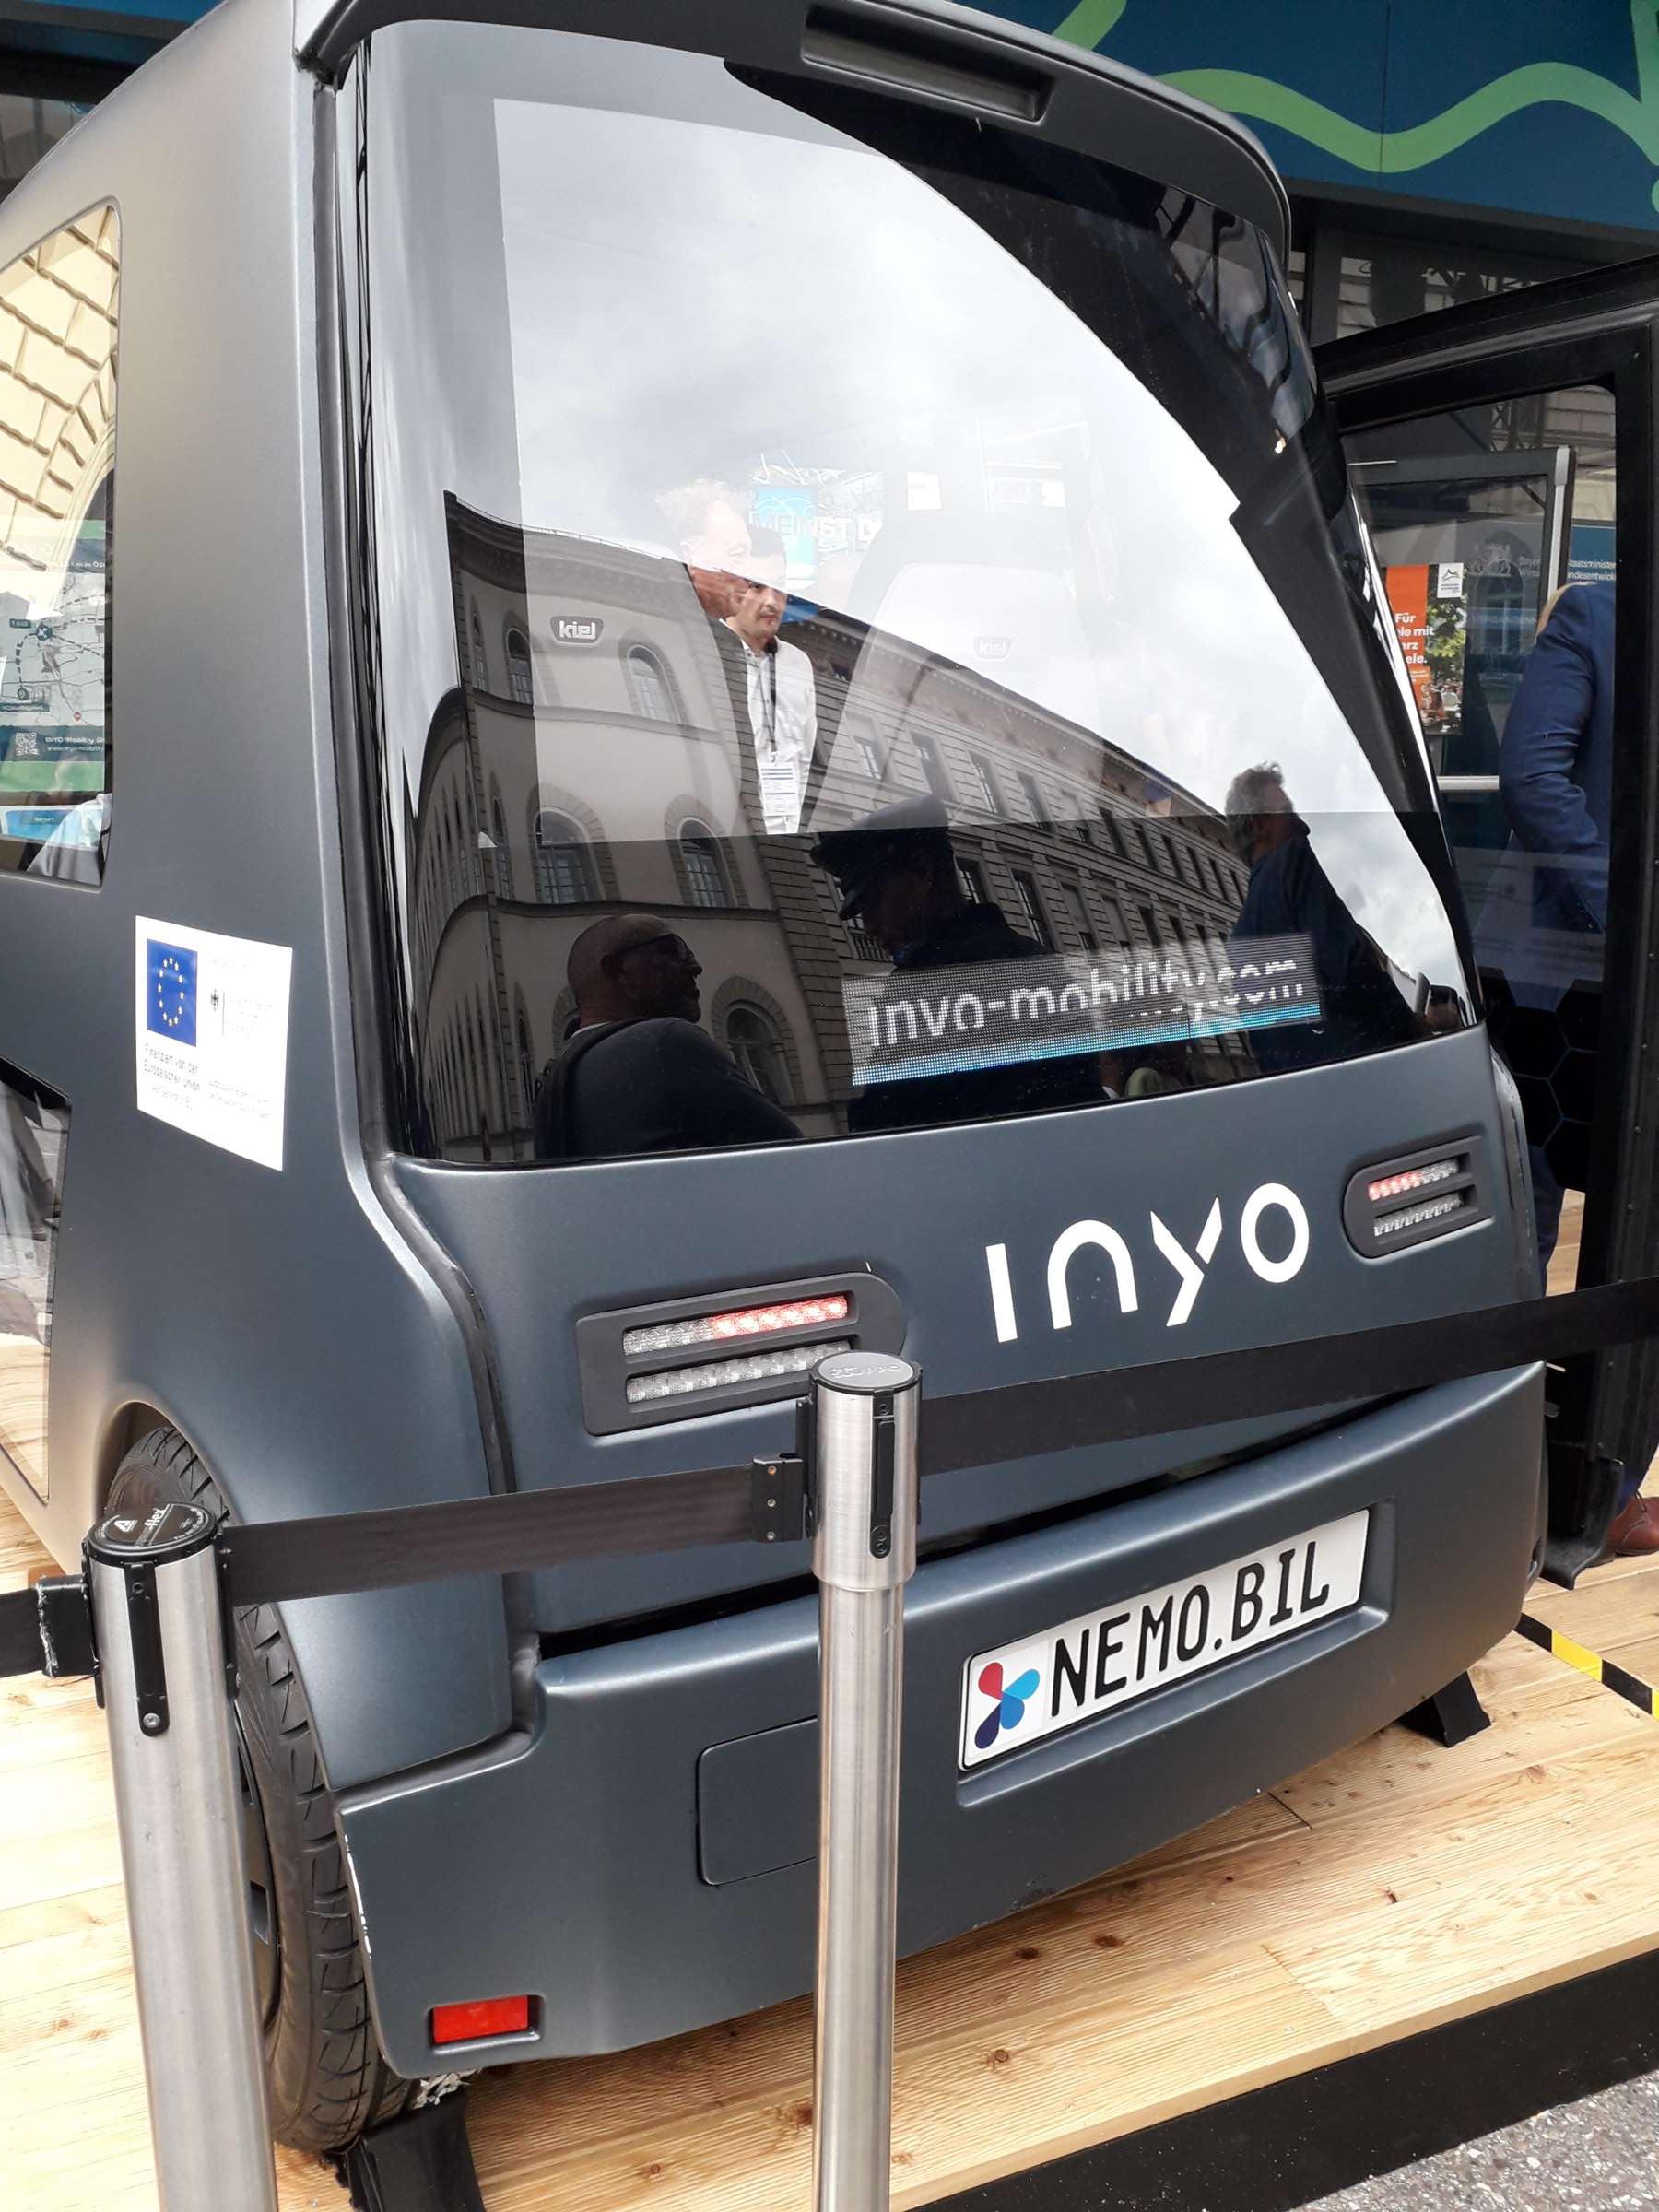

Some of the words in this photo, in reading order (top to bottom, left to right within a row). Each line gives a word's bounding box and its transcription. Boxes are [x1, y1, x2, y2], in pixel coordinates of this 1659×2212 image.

[1394, 611, 1417, 624] Für
[559, 620, 596, 640] kiel
[1413, 625, 1436, 637] mit
[1051, 1541, 1330, 1718] NEMO.BIL
